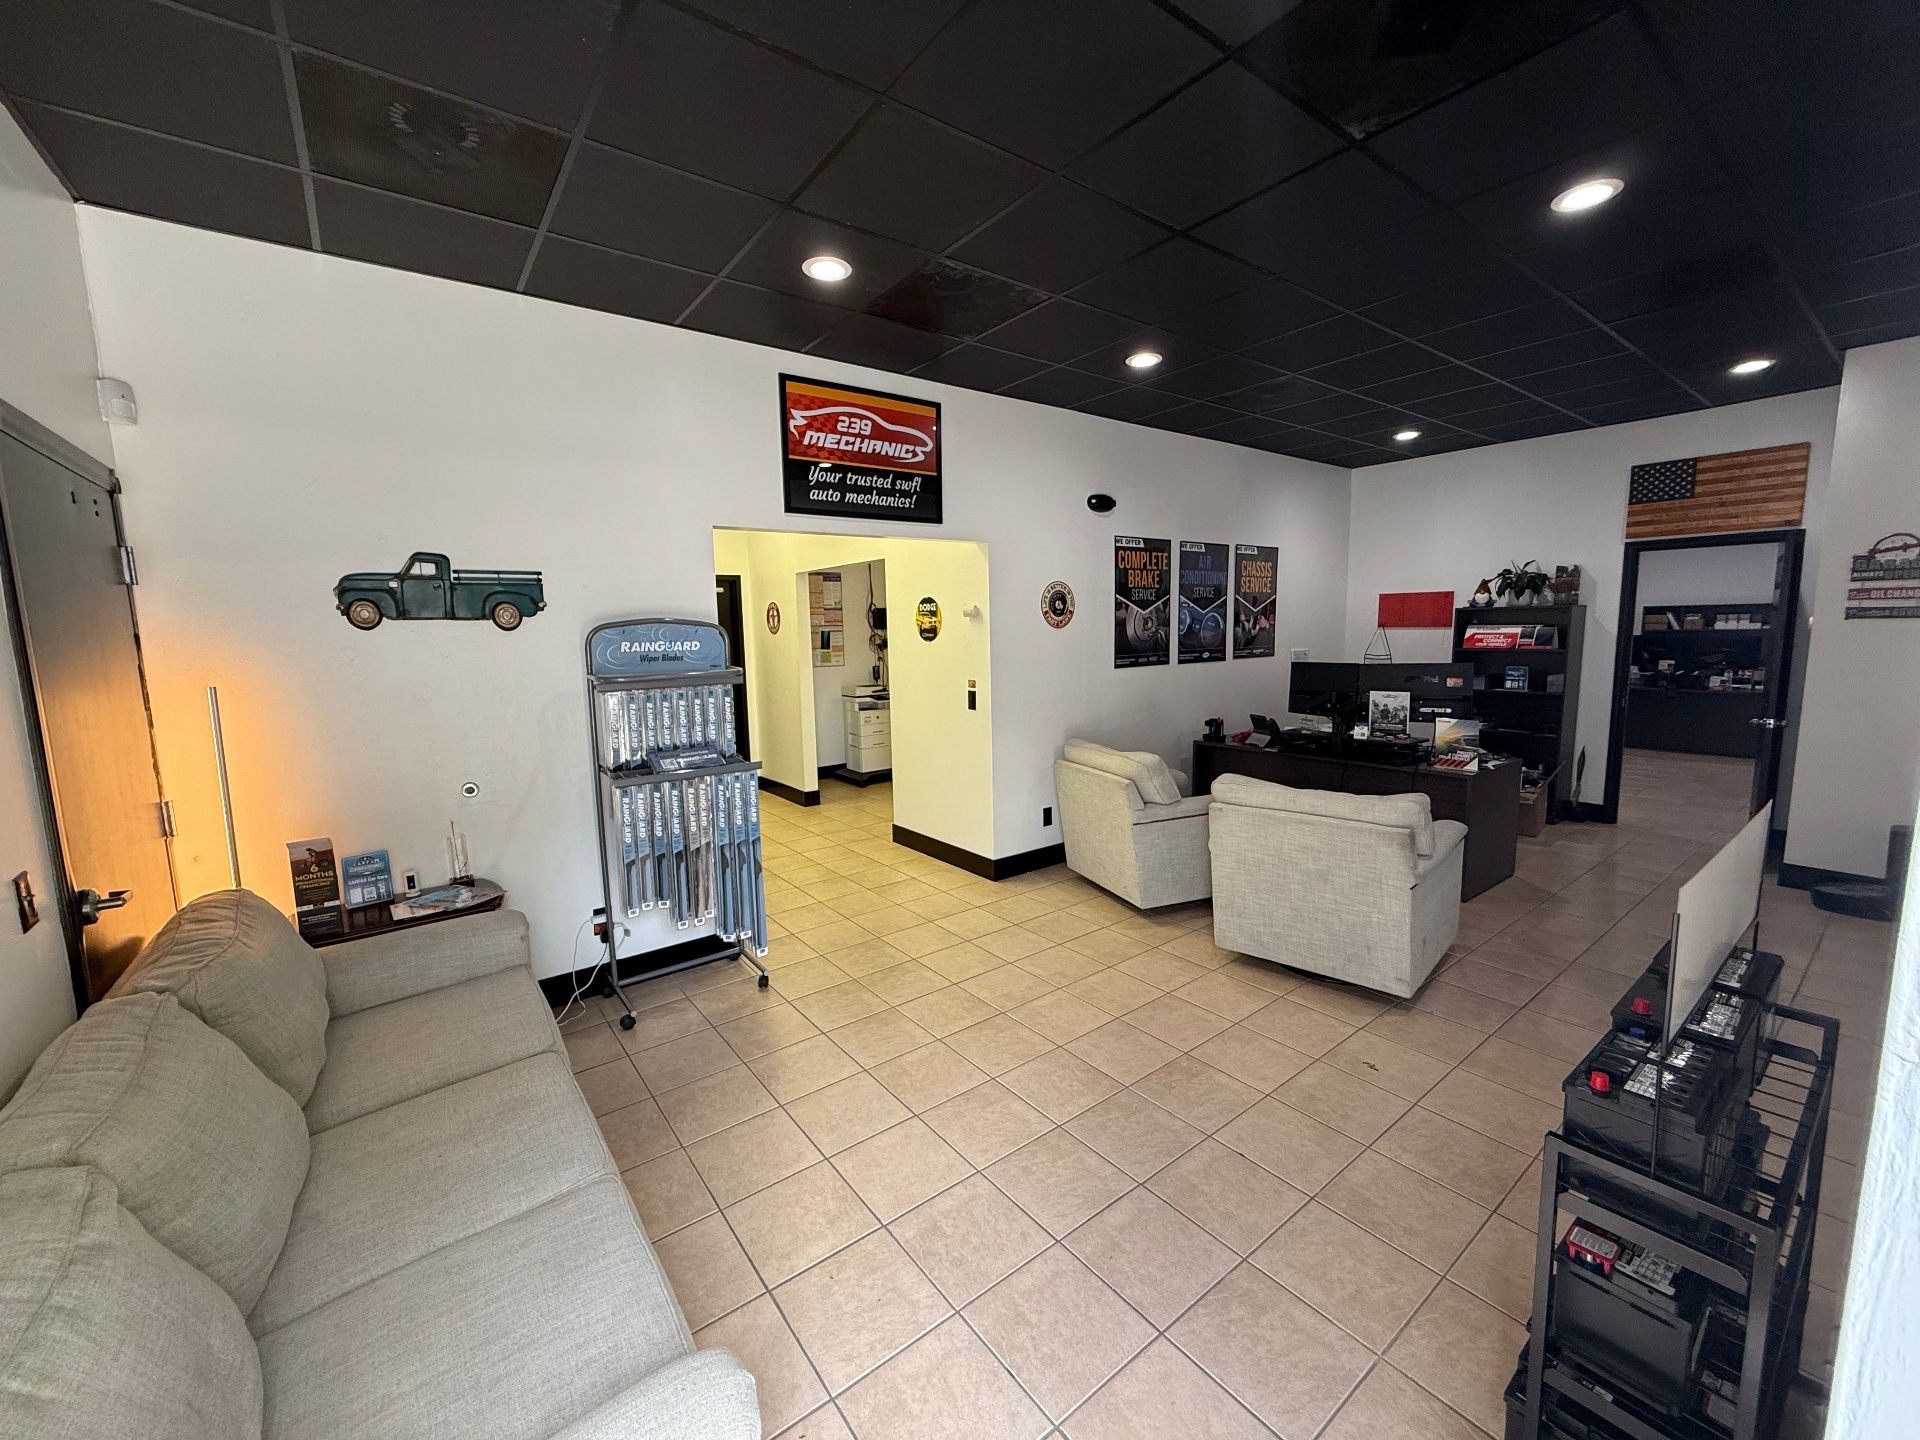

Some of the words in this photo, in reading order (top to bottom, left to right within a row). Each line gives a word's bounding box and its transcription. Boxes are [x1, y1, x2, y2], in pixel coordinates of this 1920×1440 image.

[837, 415, 873, 435] 239
[802, 430, 926, 463] MECHANICS
[808, 466, 842, 485] Your
[846, 472, 893, 489] trusted
[895, 476, 922, 493] swfl
[809, 487, 841, 502] auto
[844, 489, 917, 509] mechanics!
[1118, 550, 1169, 570] COMPLETE
[1128, 569, 1160, 588] BRAKE
[1199, 554, 1212, 569] AIR
[1241, 560, 1273, 577] CHASSIS
[1131, 588, 1157, 600] SERVICE
[1193, 587, 1215, 598] SERVICE
[1240, 576, 1272, 593] SERVICE
[1870, 590, 1886, 598] OIL
[620, 640, 701, 652] RAINGUARD
[640, 654, 660, 664] Wiper
[662, 653, 684, 662] Blades
[629, 703, 638, 748] RAINGUARD
[646, 702, 655, 747] RAINGUARD
[662, 701, 671, 745] RAINGUARD
[679, 700, 687, 743] RAINGUARD
[694, 699, 702, 742] RAINGUARD
[708, 697, 716, 740] RAINGUARD
[724, 696, 732, 739] RAINGUARD
[622, 797, 632, 844] RAINGUARD
[637, 793, 646, 838] RAINGUARD
[653, 791, 662, 837] RAINGUARD
[671, 790, 680, 834] RAINGUARD
[688, 787, 697, 832] RAINGUARD
[699, 783, 708, 827] RAINGUARD
[717, 784, 725, 828] RAINGUARD
[734, 782, 742, 825] RAINGUARD
[749, 780, 757, 823] RAINGUARD
[295, 870, 334, 882] MONTHS
[310, 863, 319, 872] 6
